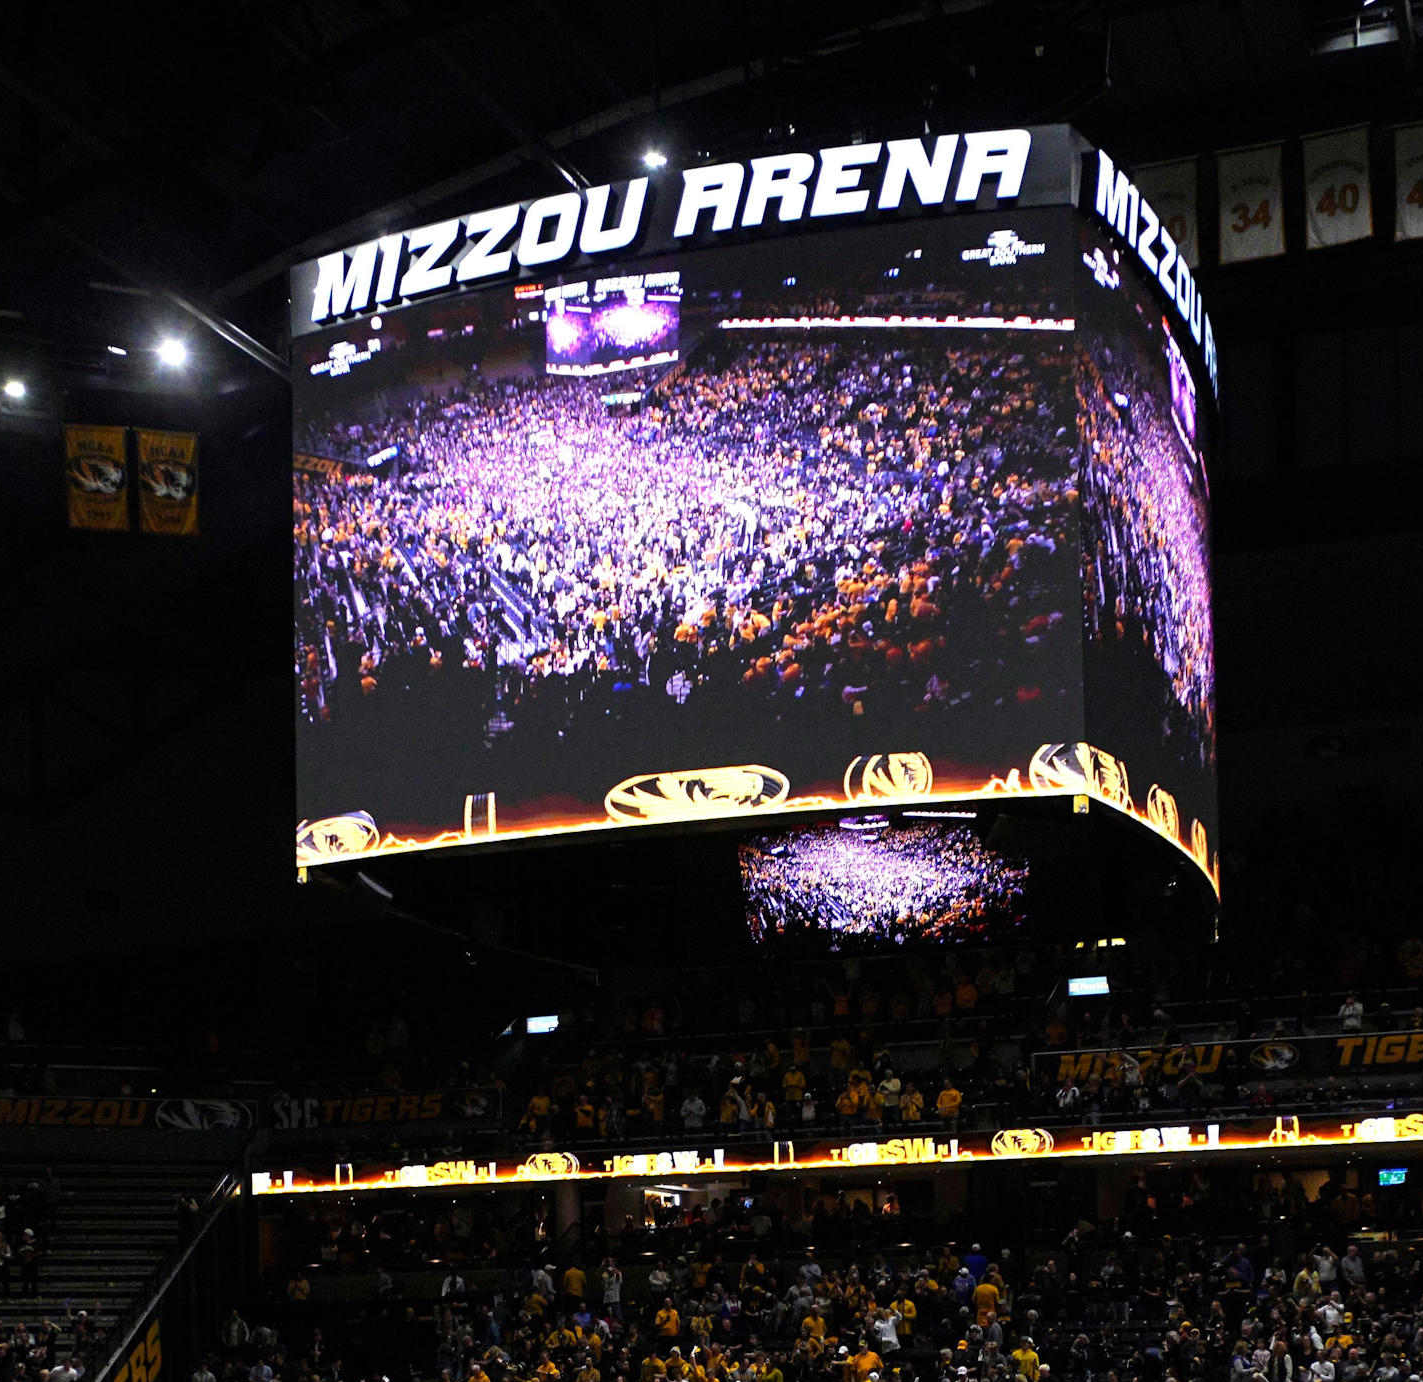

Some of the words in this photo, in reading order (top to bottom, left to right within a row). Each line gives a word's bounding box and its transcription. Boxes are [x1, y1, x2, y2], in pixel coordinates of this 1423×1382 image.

[1231, 200, 1273, 234] 34
[1316, 183, 1359, 217] 40
[311, 176, 649, 323] MIZZOU
[672, 129, 1032, 238] ARENA
[1095, 149, 1202, 345] MIZZOU
[321, 1092, 443, 1125] TIGERS
